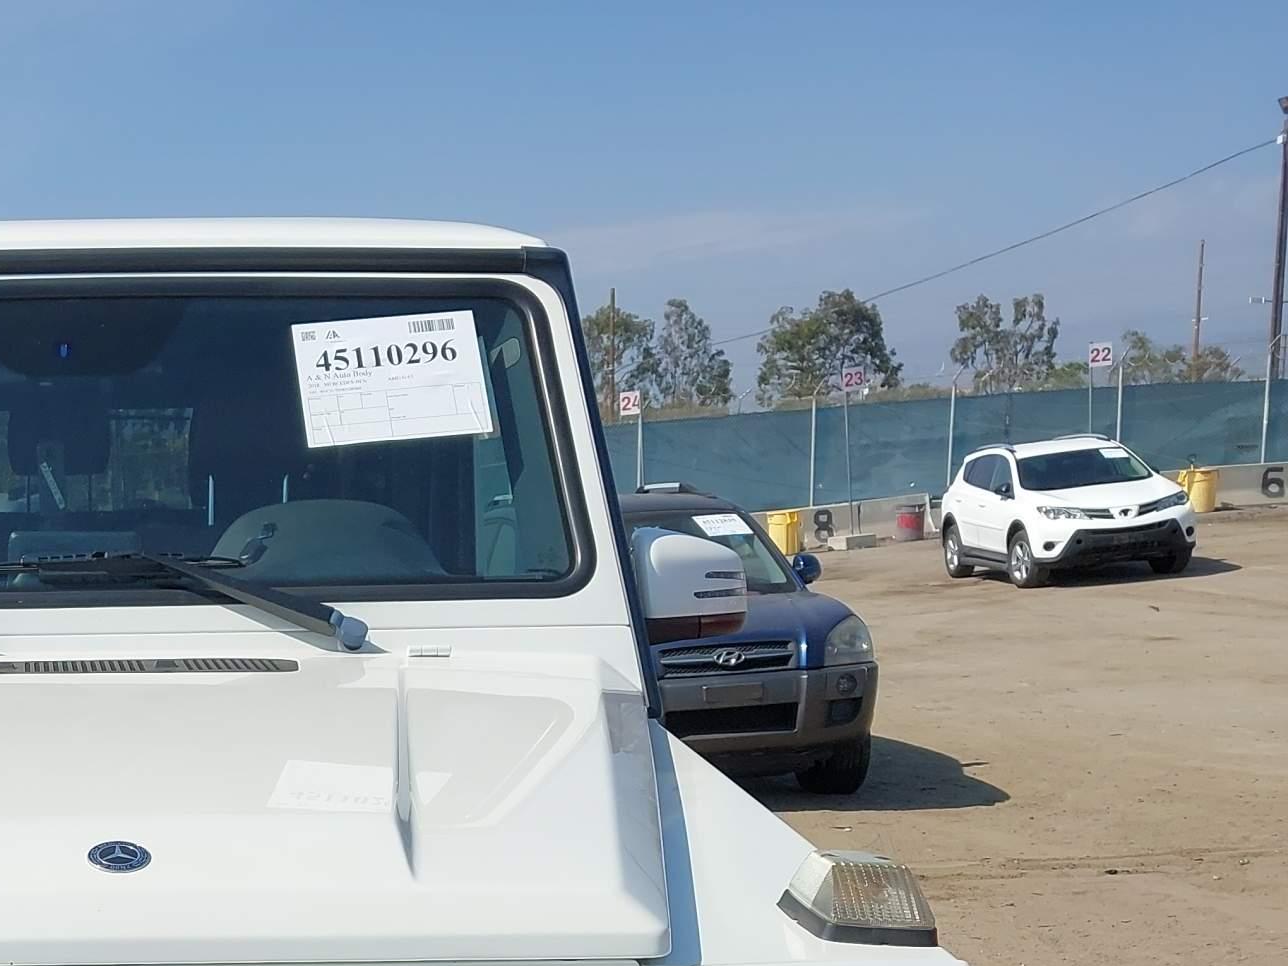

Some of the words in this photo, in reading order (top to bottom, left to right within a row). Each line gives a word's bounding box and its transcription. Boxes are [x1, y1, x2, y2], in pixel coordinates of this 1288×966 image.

[315, 339, 457, 372] 45110296
[1090, 346, 1111, 363] 22
[844, 371, 863, 387] 23
[621, 395, 641, 411] 24
[1261, 466, 1286, 498] 6
[814, 509, 834, 544] 8
